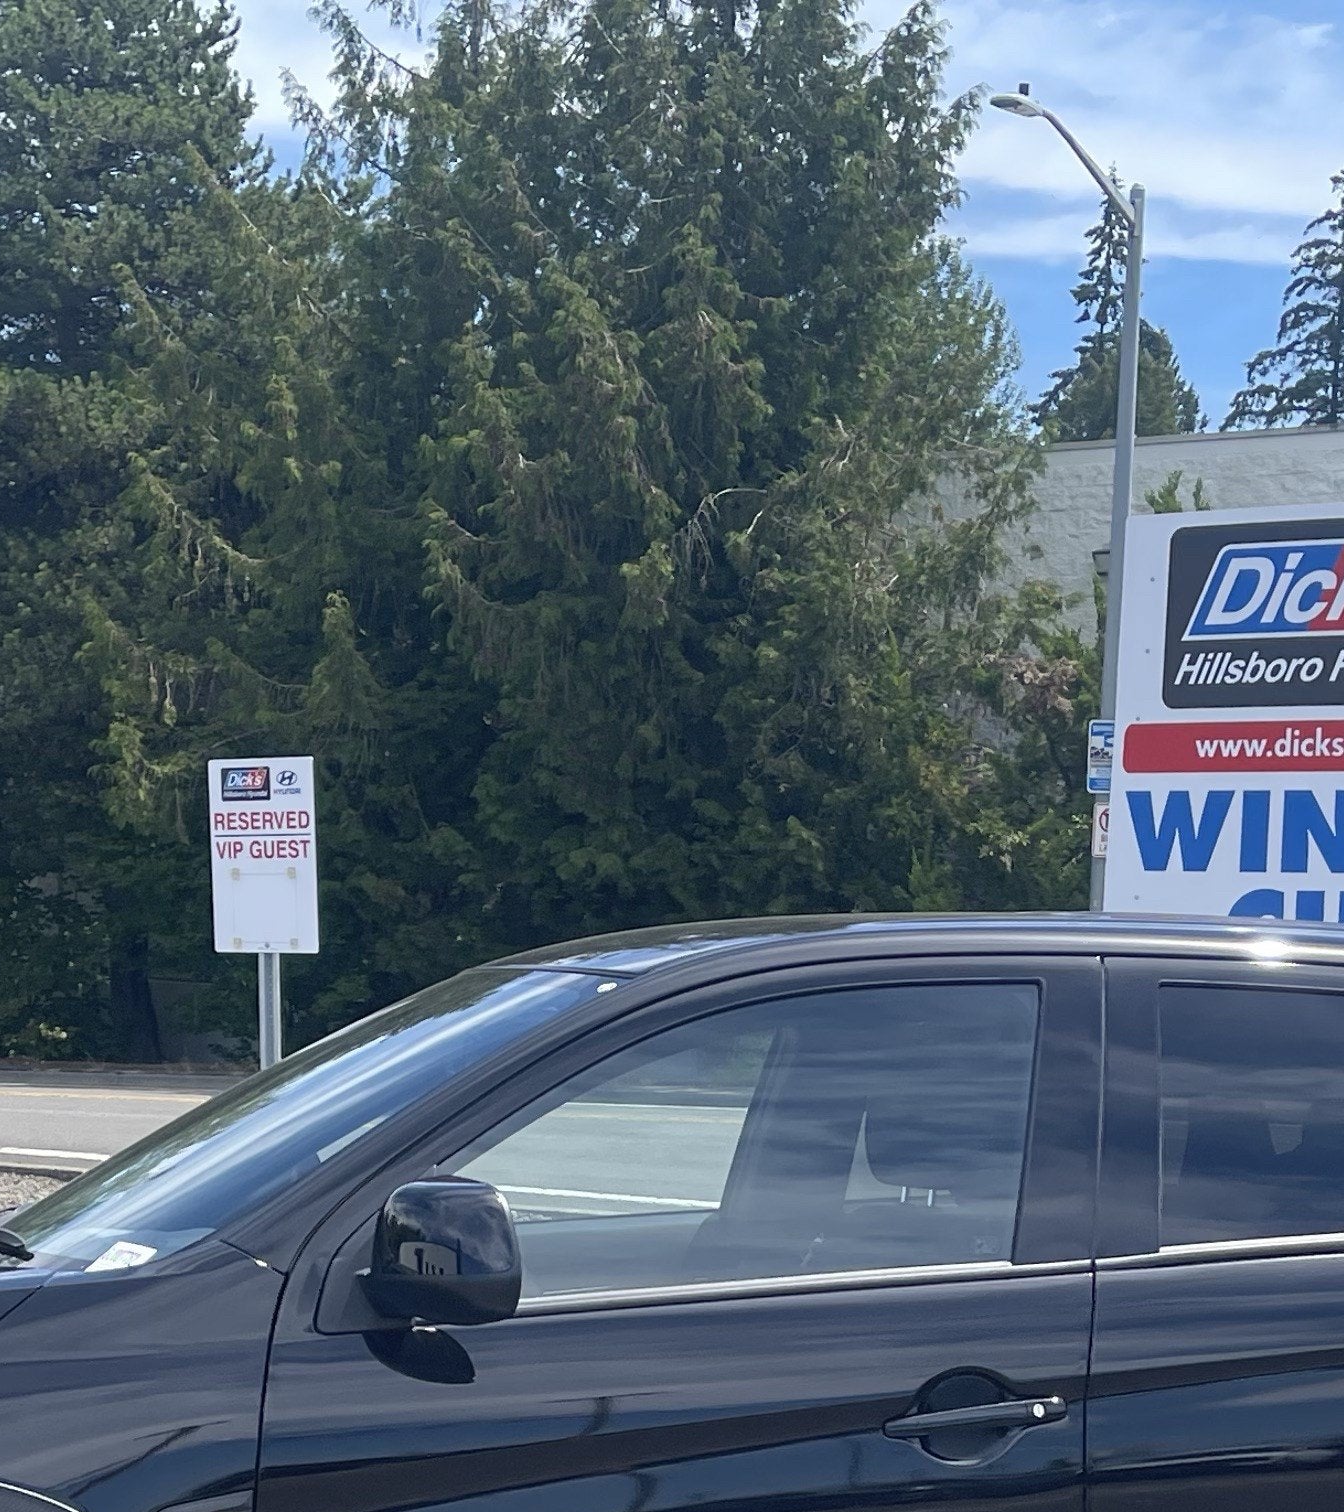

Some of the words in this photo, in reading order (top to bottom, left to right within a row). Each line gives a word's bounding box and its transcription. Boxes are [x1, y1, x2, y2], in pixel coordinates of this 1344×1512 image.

[1173, 651, 1325, 686] Hillsboro
[214, 811, 310, 831] RESERVED
[216, 841, 243, 859] VIP
[250, 840, 311, 859] GUEST
